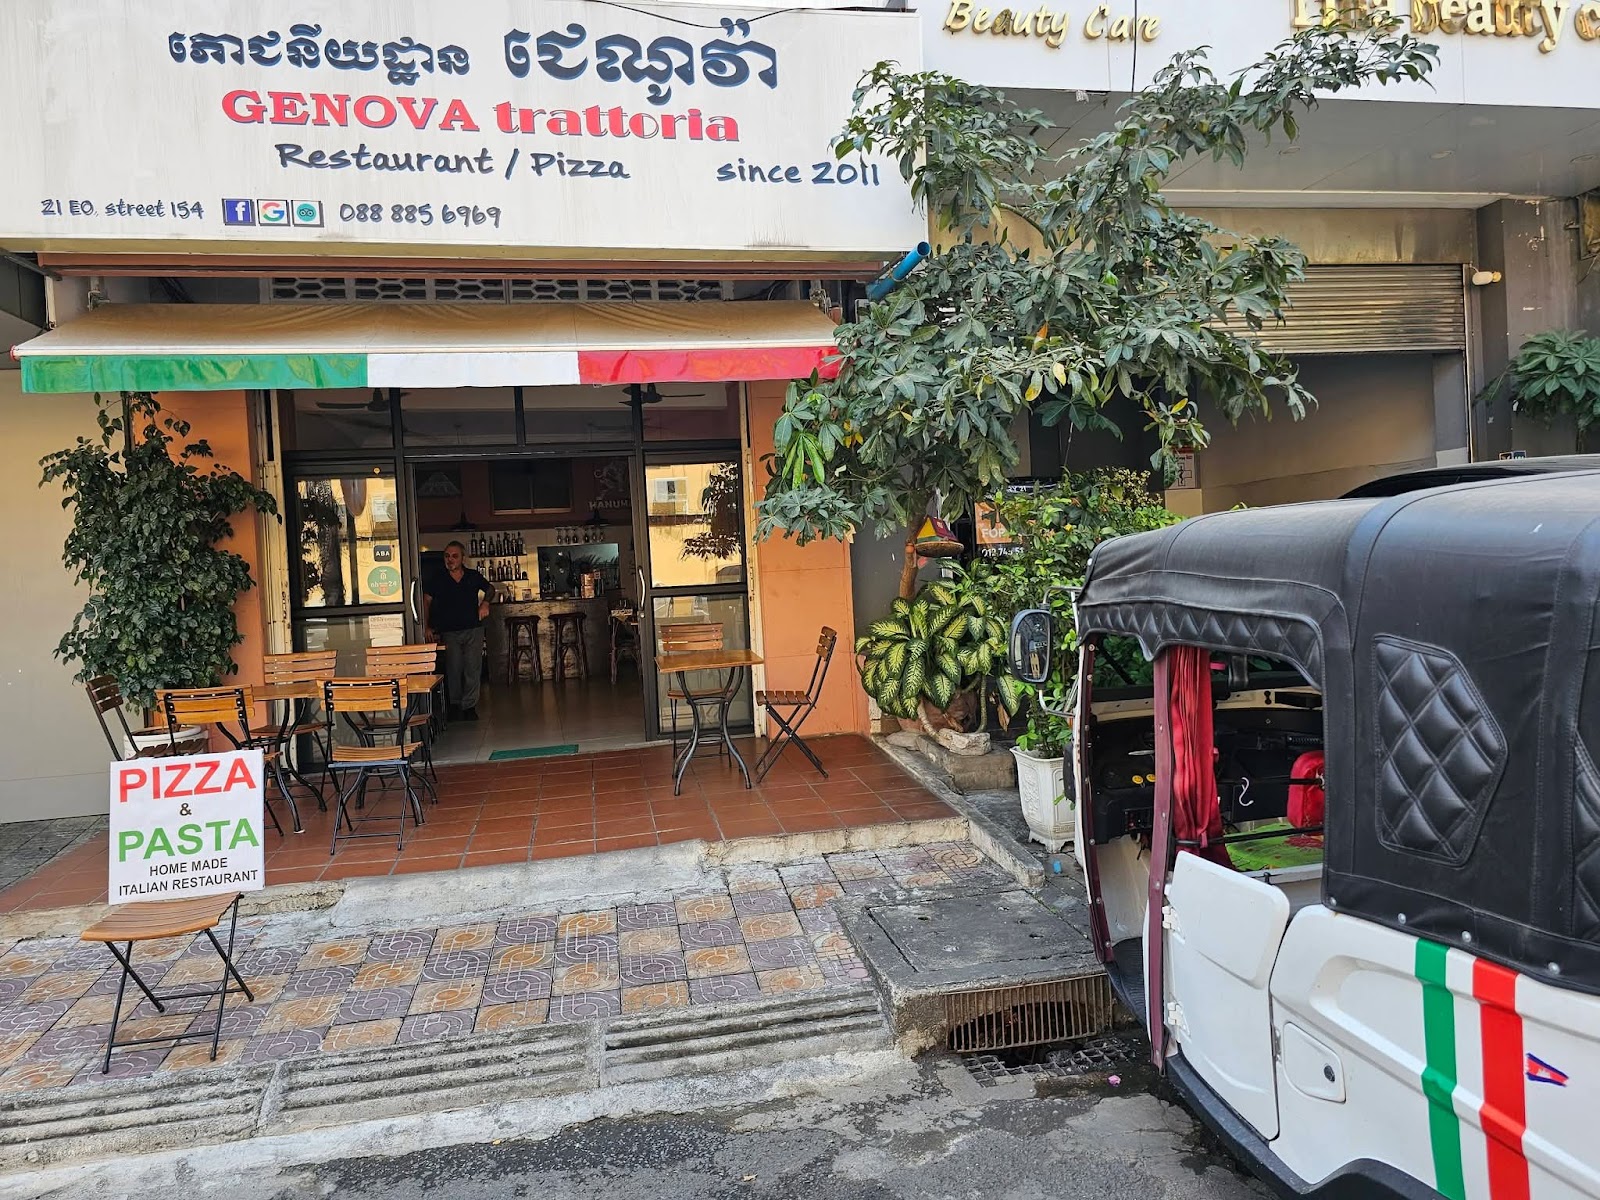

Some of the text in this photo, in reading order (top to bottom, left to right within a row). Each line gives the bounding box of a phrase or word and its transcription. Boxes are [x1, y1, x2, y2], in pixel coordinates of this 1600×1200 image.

[943, 0, 1162, 48] Beauty Care
[1410, 0, 1570, 53] beauty
[221, 89, 740, 142] GENOVA trattoria
[274, 143, 631, 180] Restaurant / Pizza
[717, 158, 880, 186] since 2011
[41, 199, 62, 215] 21
[105, 199, 166, 217] street
[171, 201, 204, 219] 154
[339, 203, 502, 228] 088 885 6969
[588, 499, 630, 511] HANUM
[119, 757, 257, 803] PIZZA
[179, 803, 192, 816] &
[118, 818, 260, 862] PASTA
[149, 857, 228, 877] HOME MADE
[119, 869, 258, 896] ITALIAN RESTAURANT
